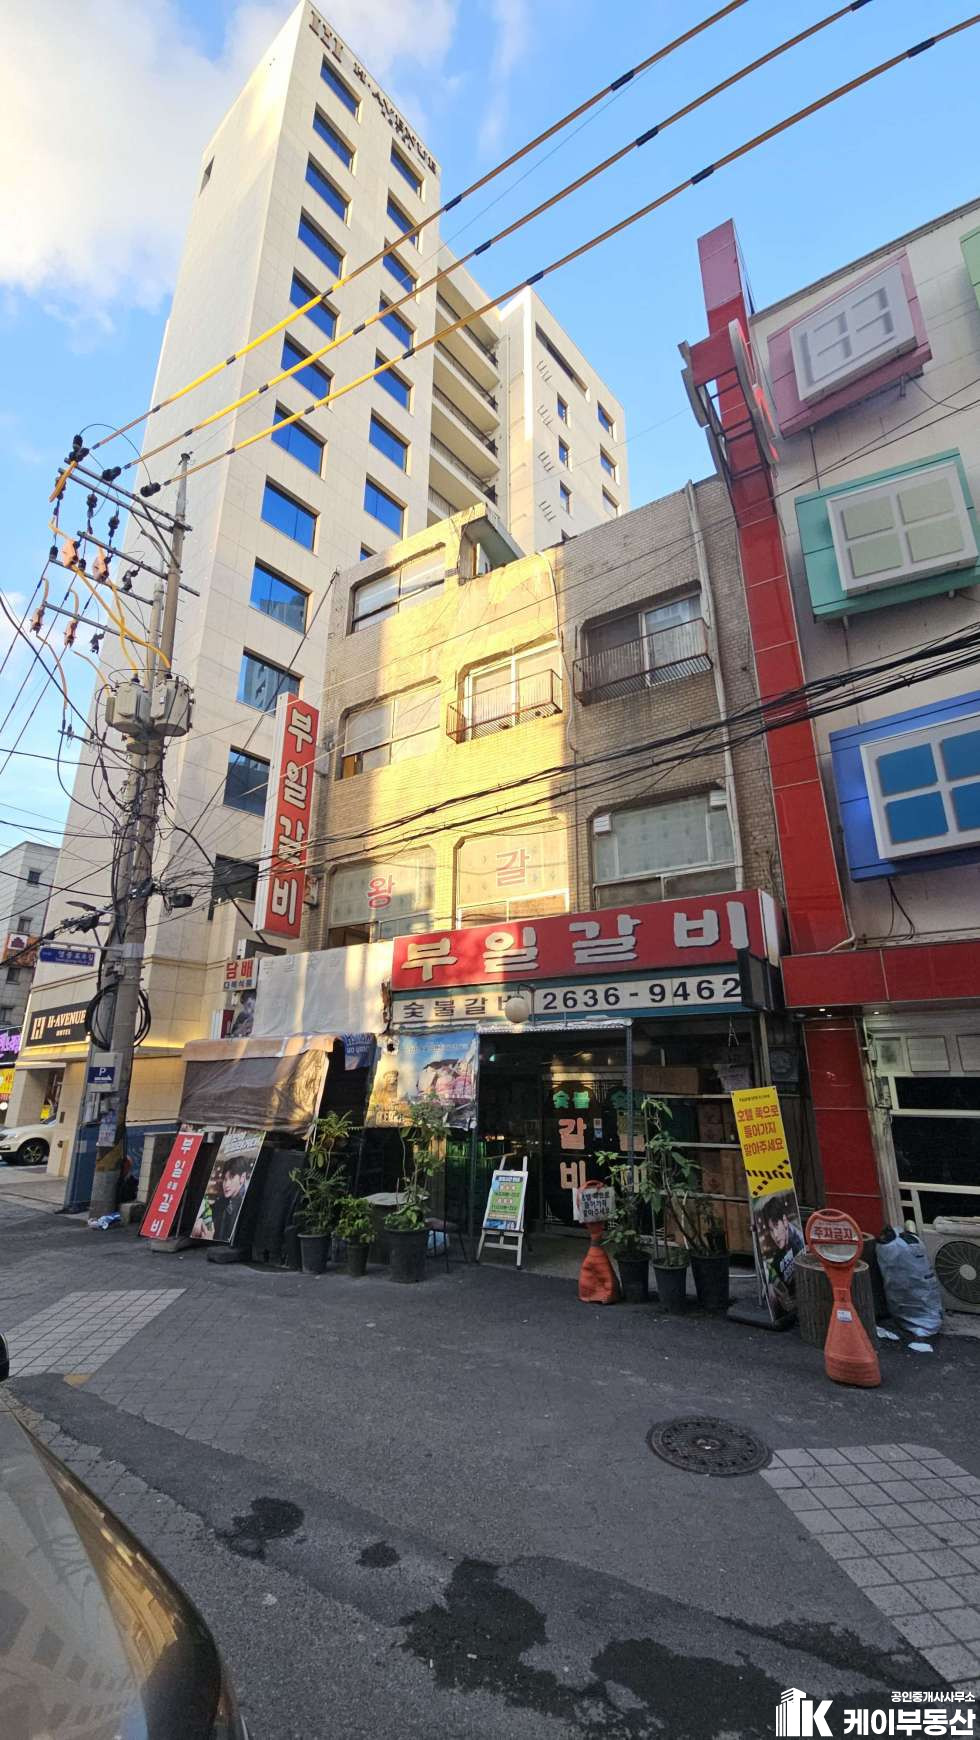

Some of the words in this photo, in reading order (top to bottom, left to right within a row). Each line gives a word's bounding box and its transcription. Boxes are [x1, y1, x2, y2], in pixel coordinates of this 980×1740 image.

[272, 707, 313, 925] 부일갈비
[367, 874, 395, 909] 왕
[496, 848, 530, 888] 갈
[401, 901, 750, 982] 부일갈비
[226, 959, 254, 980] 담배
[543, 977, 742, 1011] 2636-9462
[98, 1067, 106, 1076] P
[743, 1122, 777, 1138] 들어가지
[814, 1226, 853, 1240] 주차금지
